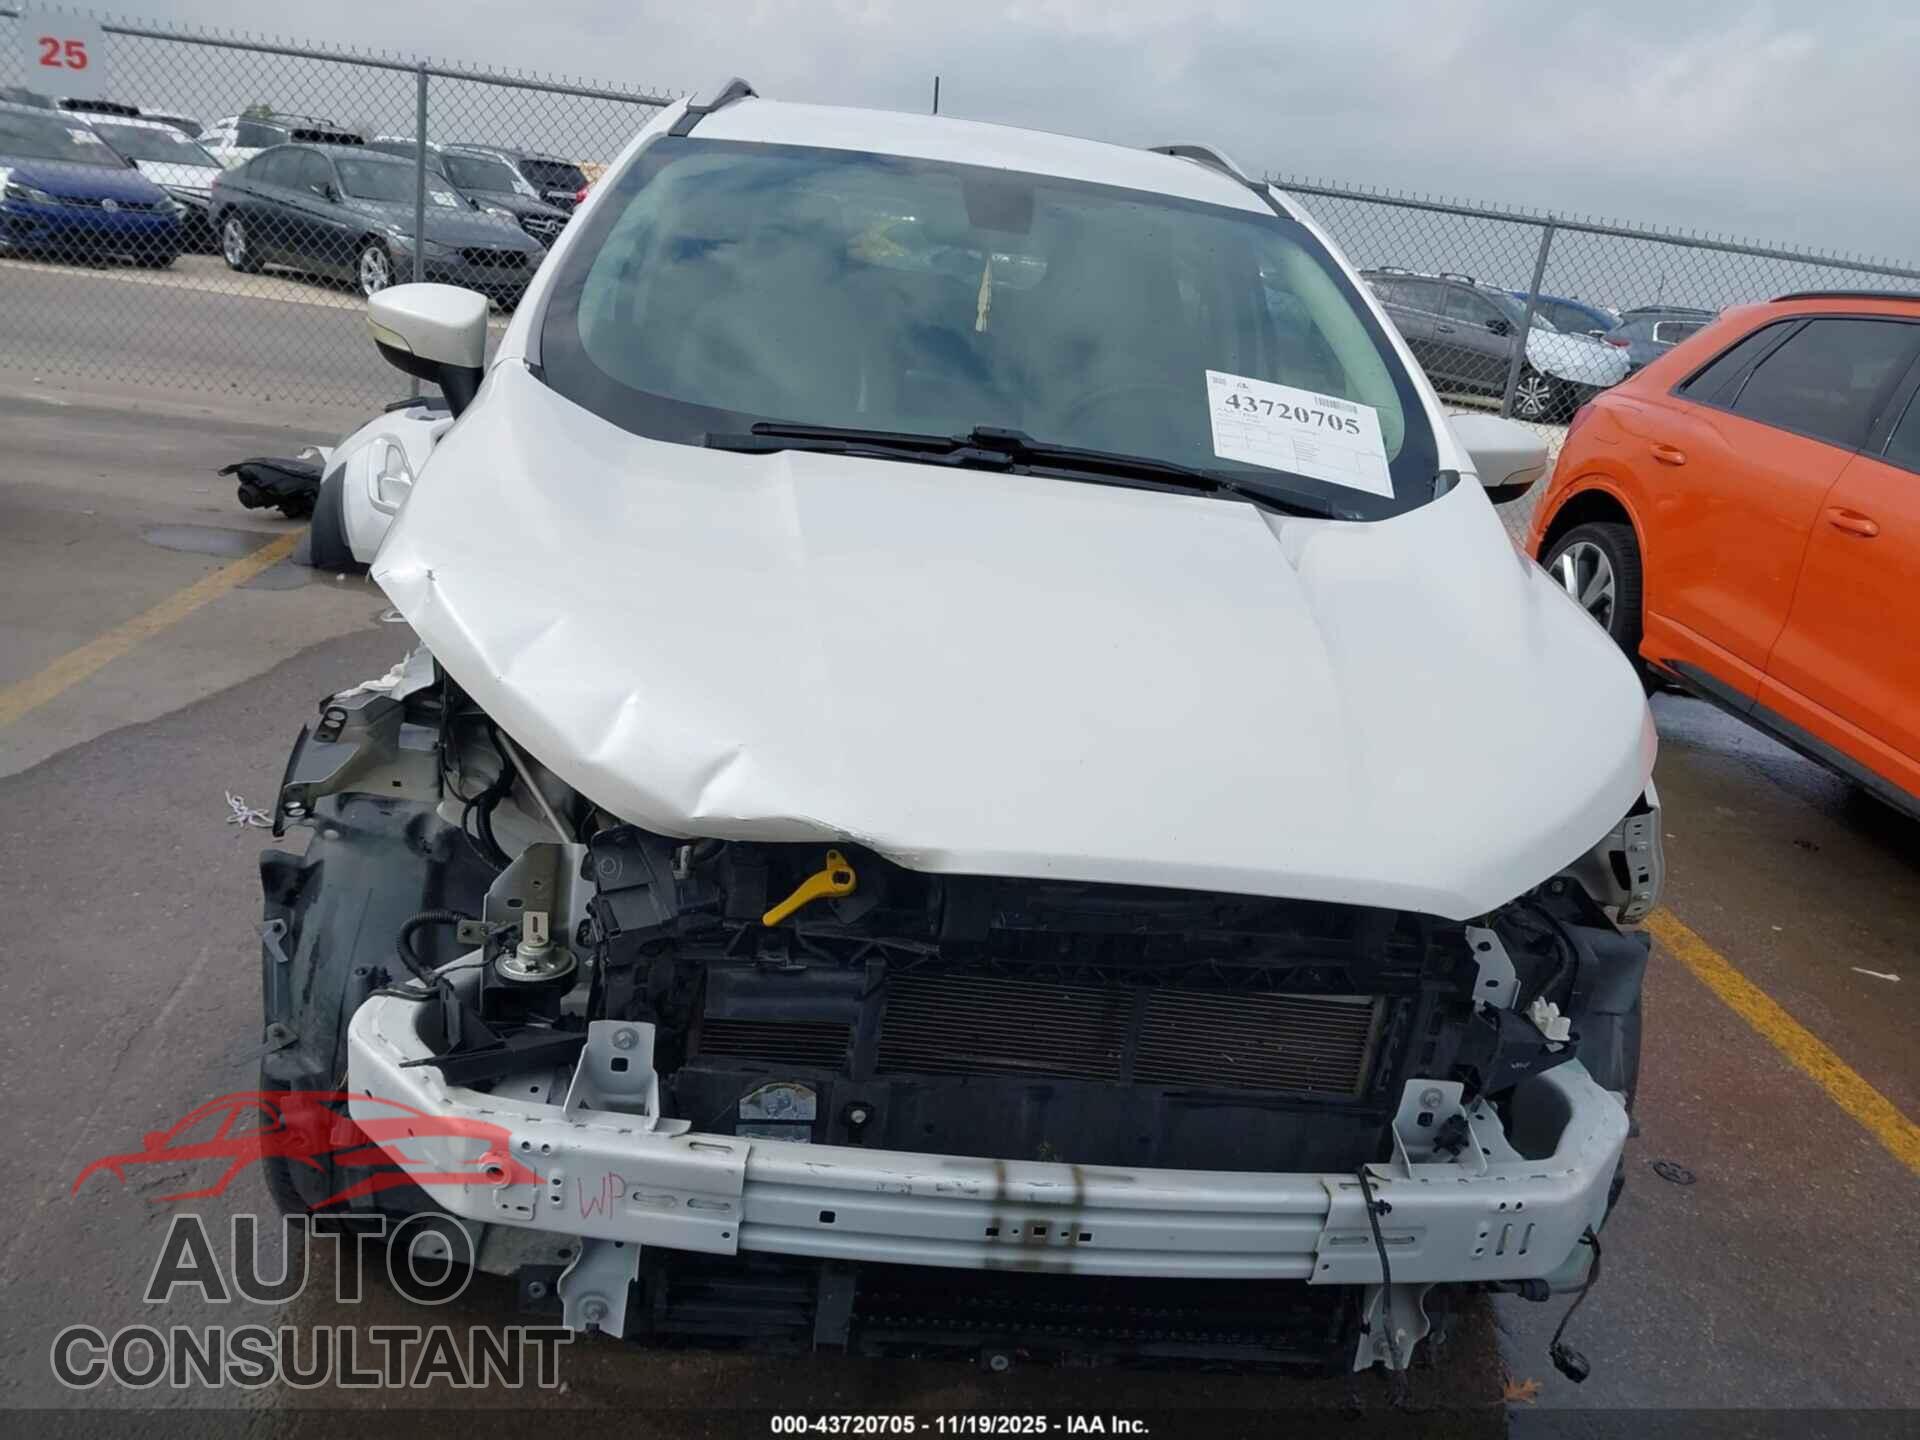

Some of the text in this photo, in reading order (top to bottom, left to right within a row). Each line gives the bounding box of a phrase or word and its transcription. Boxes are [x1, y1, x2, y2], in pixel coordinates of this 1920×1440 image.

[39, 37, 88, 70] 25
[1225, 393, 1361, 435] 43720705
[577, 1171, 626, 1220] WP
